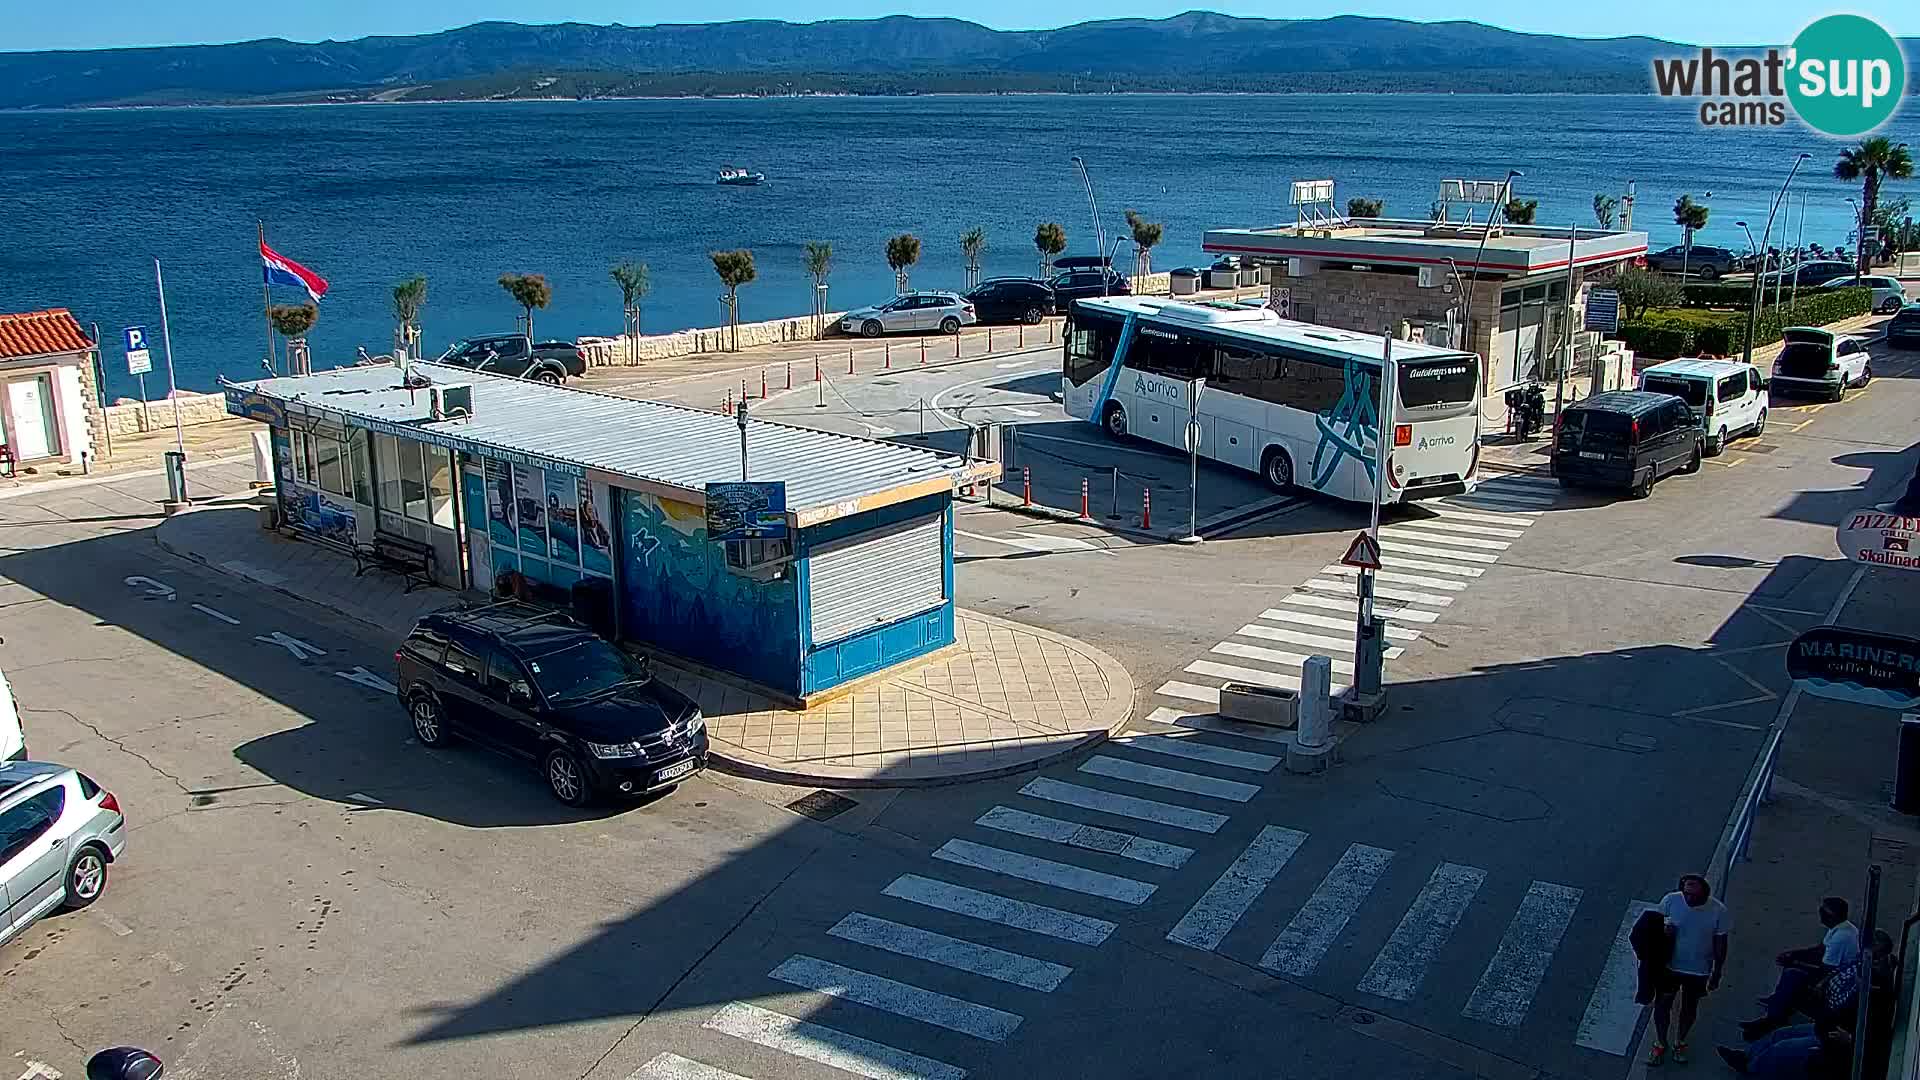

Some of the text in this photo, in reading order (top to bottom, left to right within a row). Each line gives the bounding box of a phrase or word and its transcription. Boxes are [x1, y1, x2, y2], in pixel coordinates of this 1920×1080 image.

[129, 330, 142, 348] P
[1147, 380, 1177, 398] arriva
[1429, 436, 1454, 447] arriva
[436, 435, 467, 450] POSTAJA
[478, 446, 492, 456] BUS
[493, 449, 525, 464] STATION
[527, 456, 553, 470] TICKET
[555, 461, 581, 476] OFFICE
[1880, 529, 1916, 539] GRILL
[1870, 664, 1896, 678] bar
